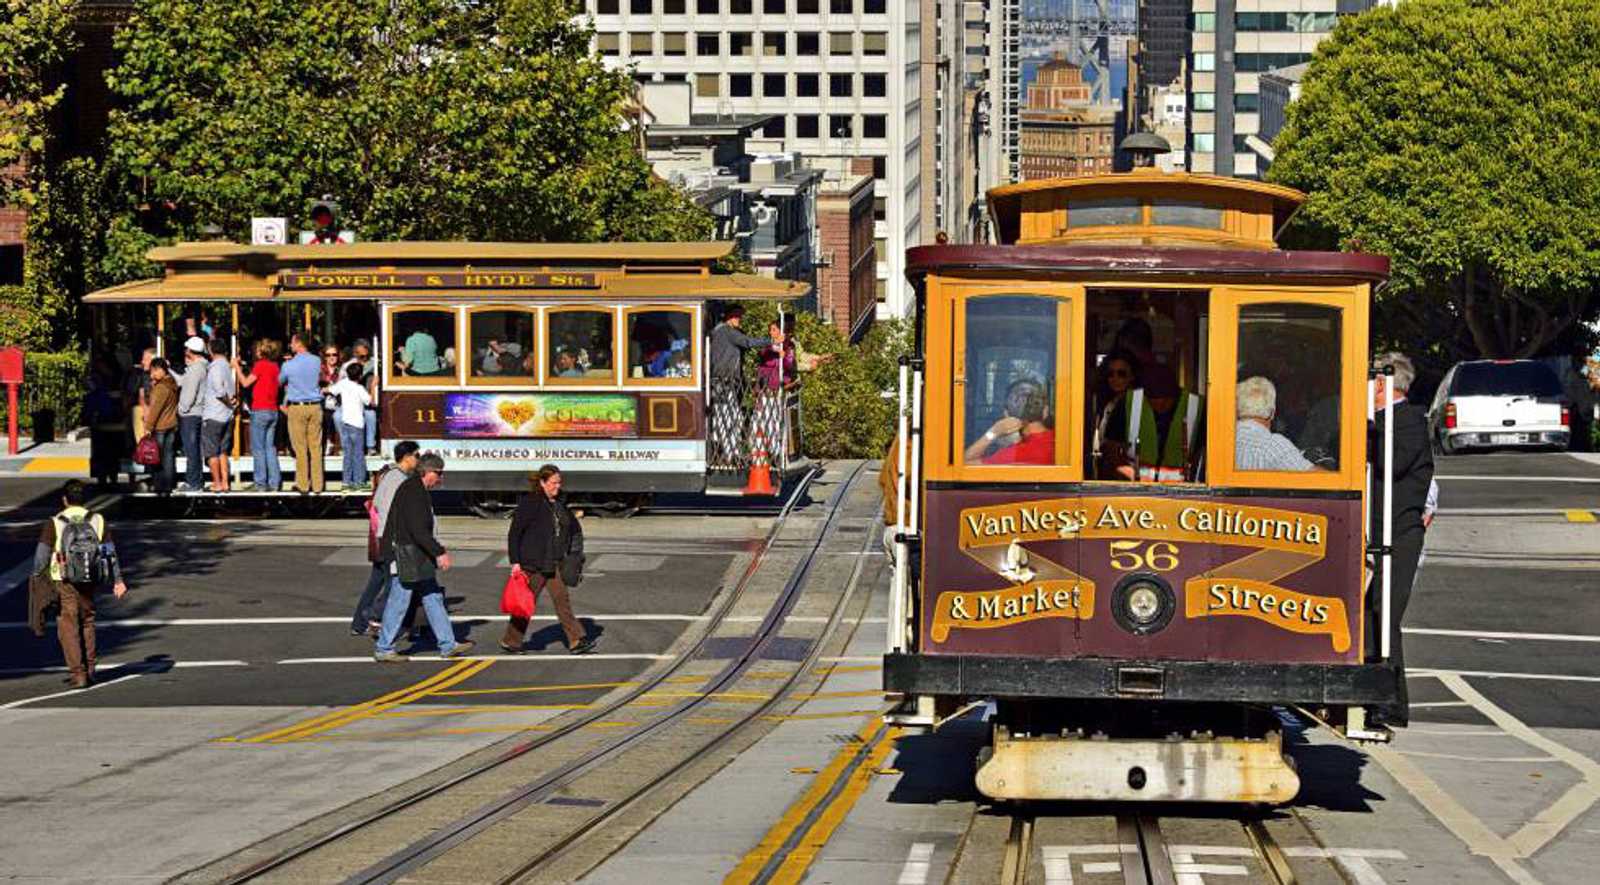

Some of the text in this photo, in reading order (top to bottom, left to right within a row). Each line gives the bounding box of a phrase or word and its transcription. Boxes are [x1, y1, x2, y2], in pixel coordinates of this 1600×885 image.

[297, 273, 405, 287] POWELL
[426, 274, 444, 286] &
[465, 273, 536, 287] HYDE
[415, 409, 437, 423] 11
[456, 449, 530, 459] FRANCISCO
[535, 449, 604, 459] MUNICIPAL
[608, 450, 660, 461] RAILWAY
[966, 511, 1017, 539] Van
[1019, 506, 1089, 534] Ness
[1179, 507, 1321, 545] California
[1110, 541, 1179, 571] 56
[950, 584, 1081, 621] & Market
[1208, 584, 1330, 624] Streets
